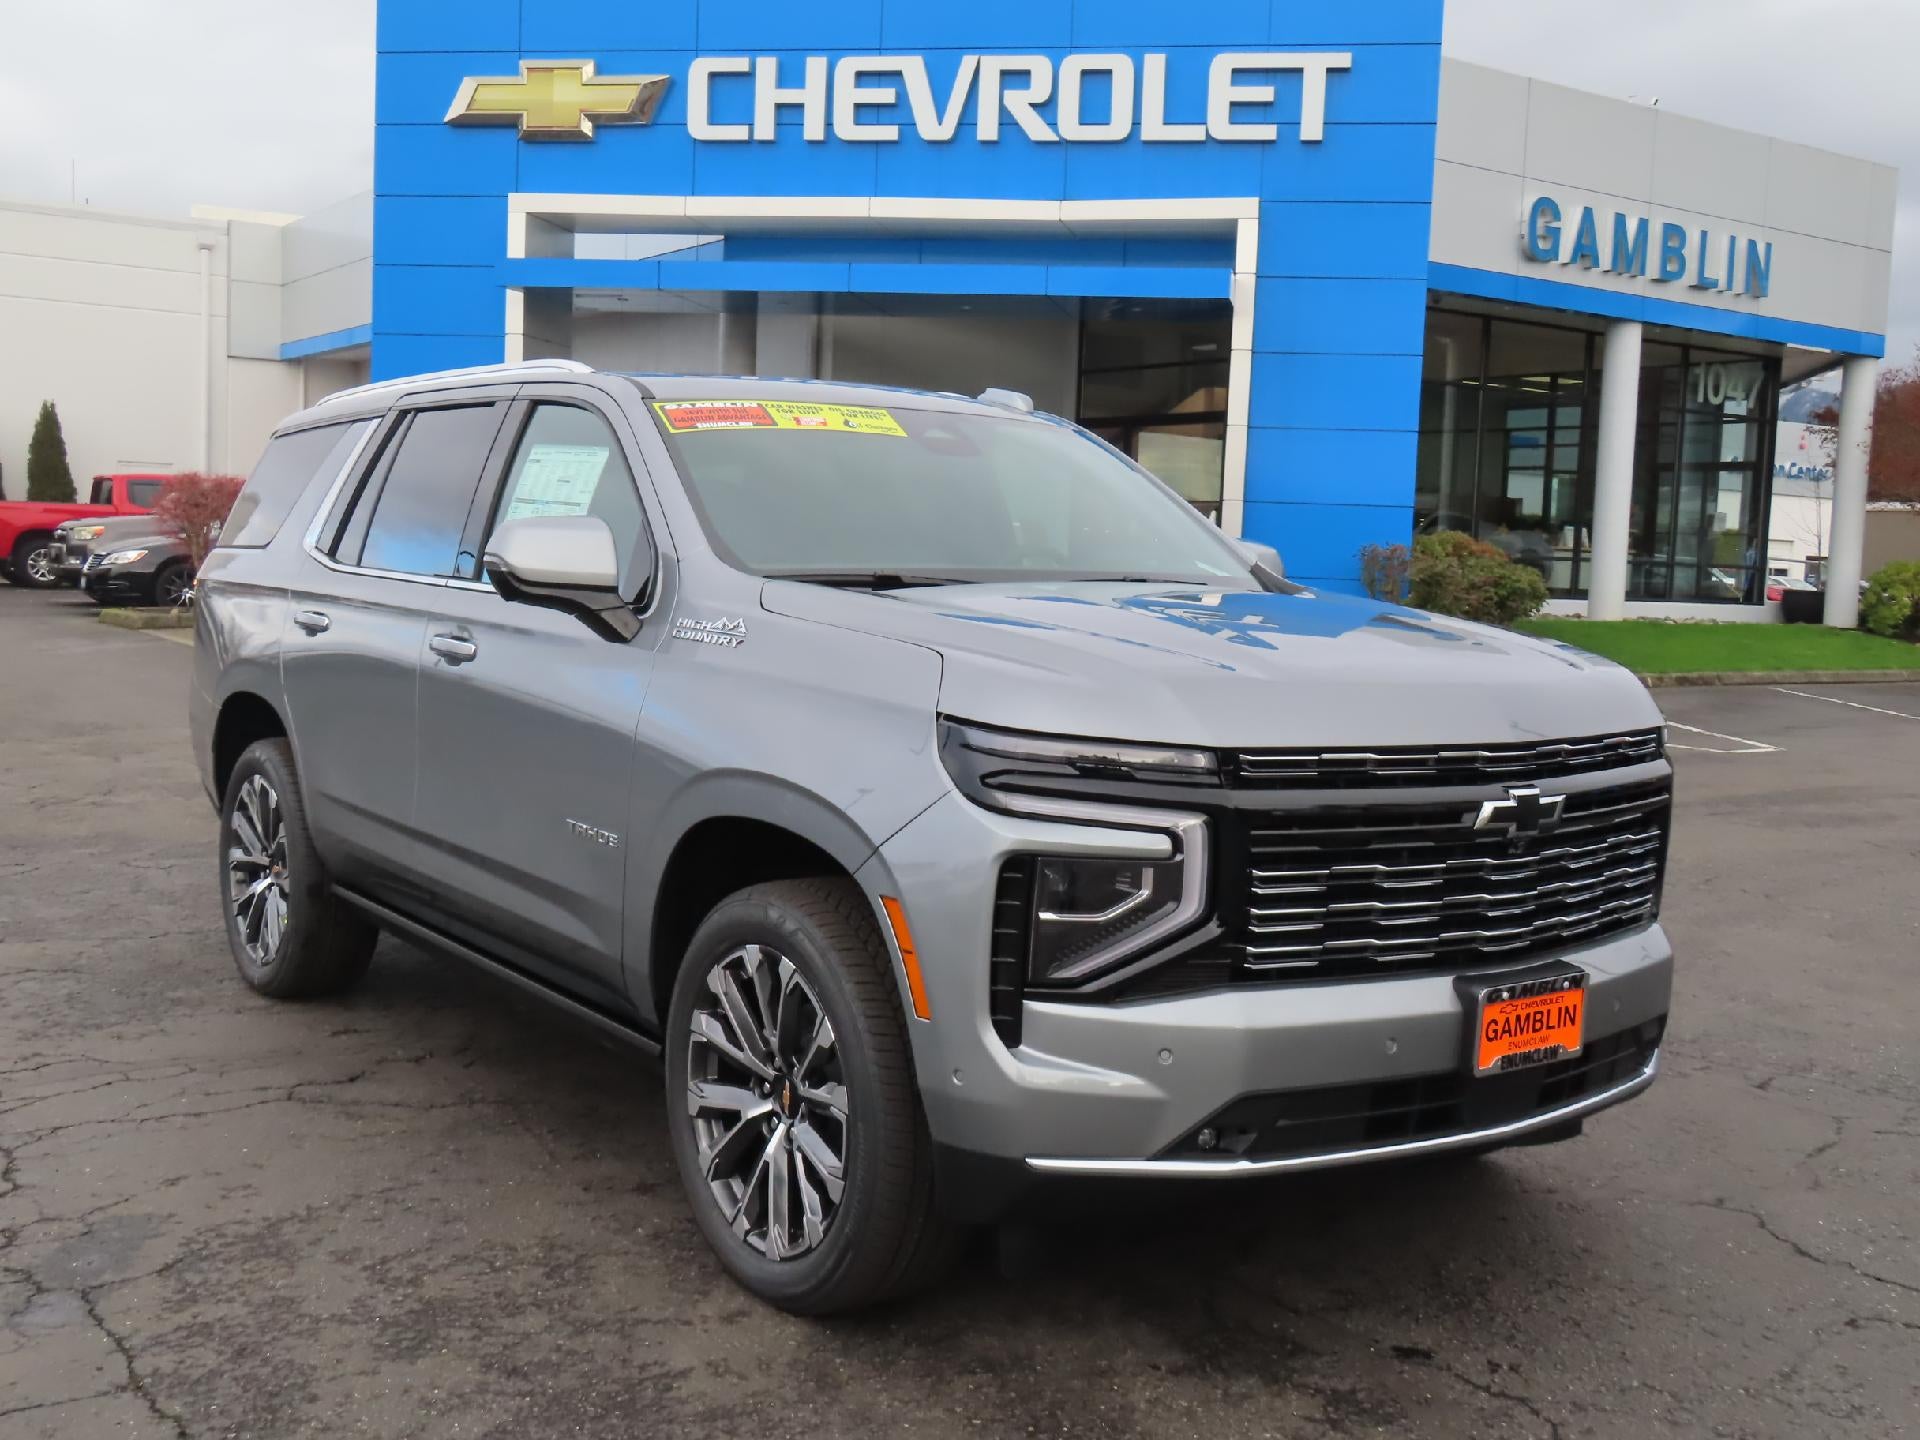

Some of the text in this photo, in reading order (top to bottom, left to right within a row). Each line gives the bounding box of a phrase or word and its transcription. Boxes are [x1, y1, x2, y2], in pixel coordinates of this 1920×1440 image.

[687, 52, 1352, 142] CHEVROLET
[1525, 196, 1772, 298] GAMBLIN
[1693, 362, 1765, 409] 1047
[672, 628, 745, 648] COUNTRY
[676, 618, 713, 630] HIGH
[566, 818, 619, 848] TAHOE
[1520, 996, 1565, 1010] CHEVROLET
[1485, 1004, 1577, 1043] GAMBLIN
[1508, 1034, 1551, 1051] ENUMCLAW
